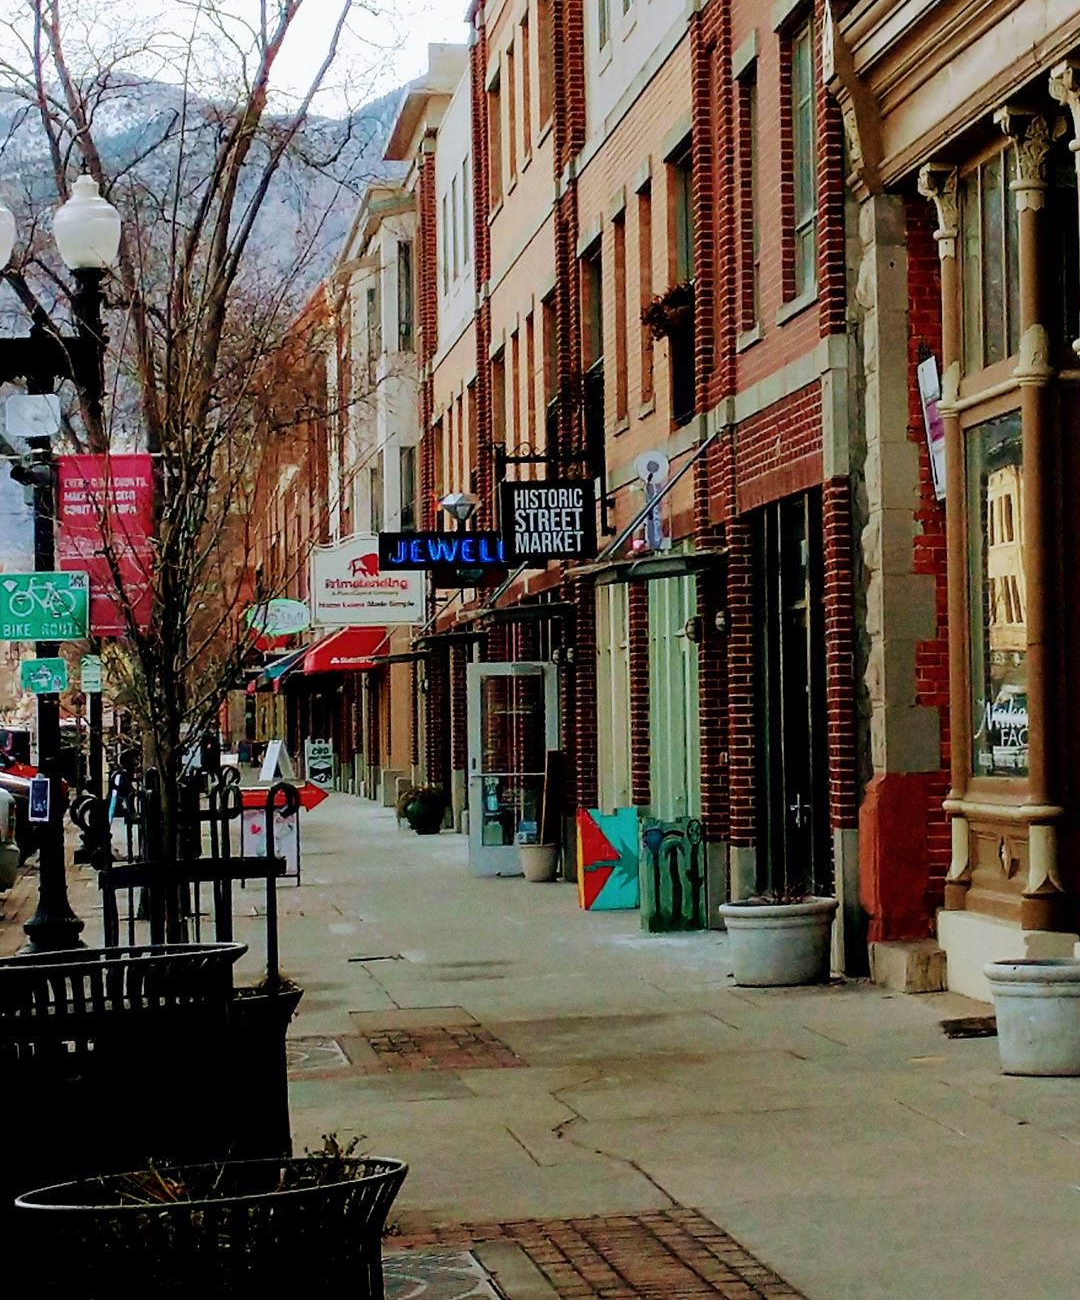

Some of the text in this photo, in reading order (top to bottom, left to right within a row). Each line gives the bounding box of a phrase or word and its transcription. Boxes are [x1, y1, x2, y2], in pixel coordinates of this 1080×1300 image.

[514, 488, 583, 508] HISTORIC
[515, 508, 583, 532] STREET
[515, 530, 585, 554] MARKET
[3, 624, 31, 637] BIKE
